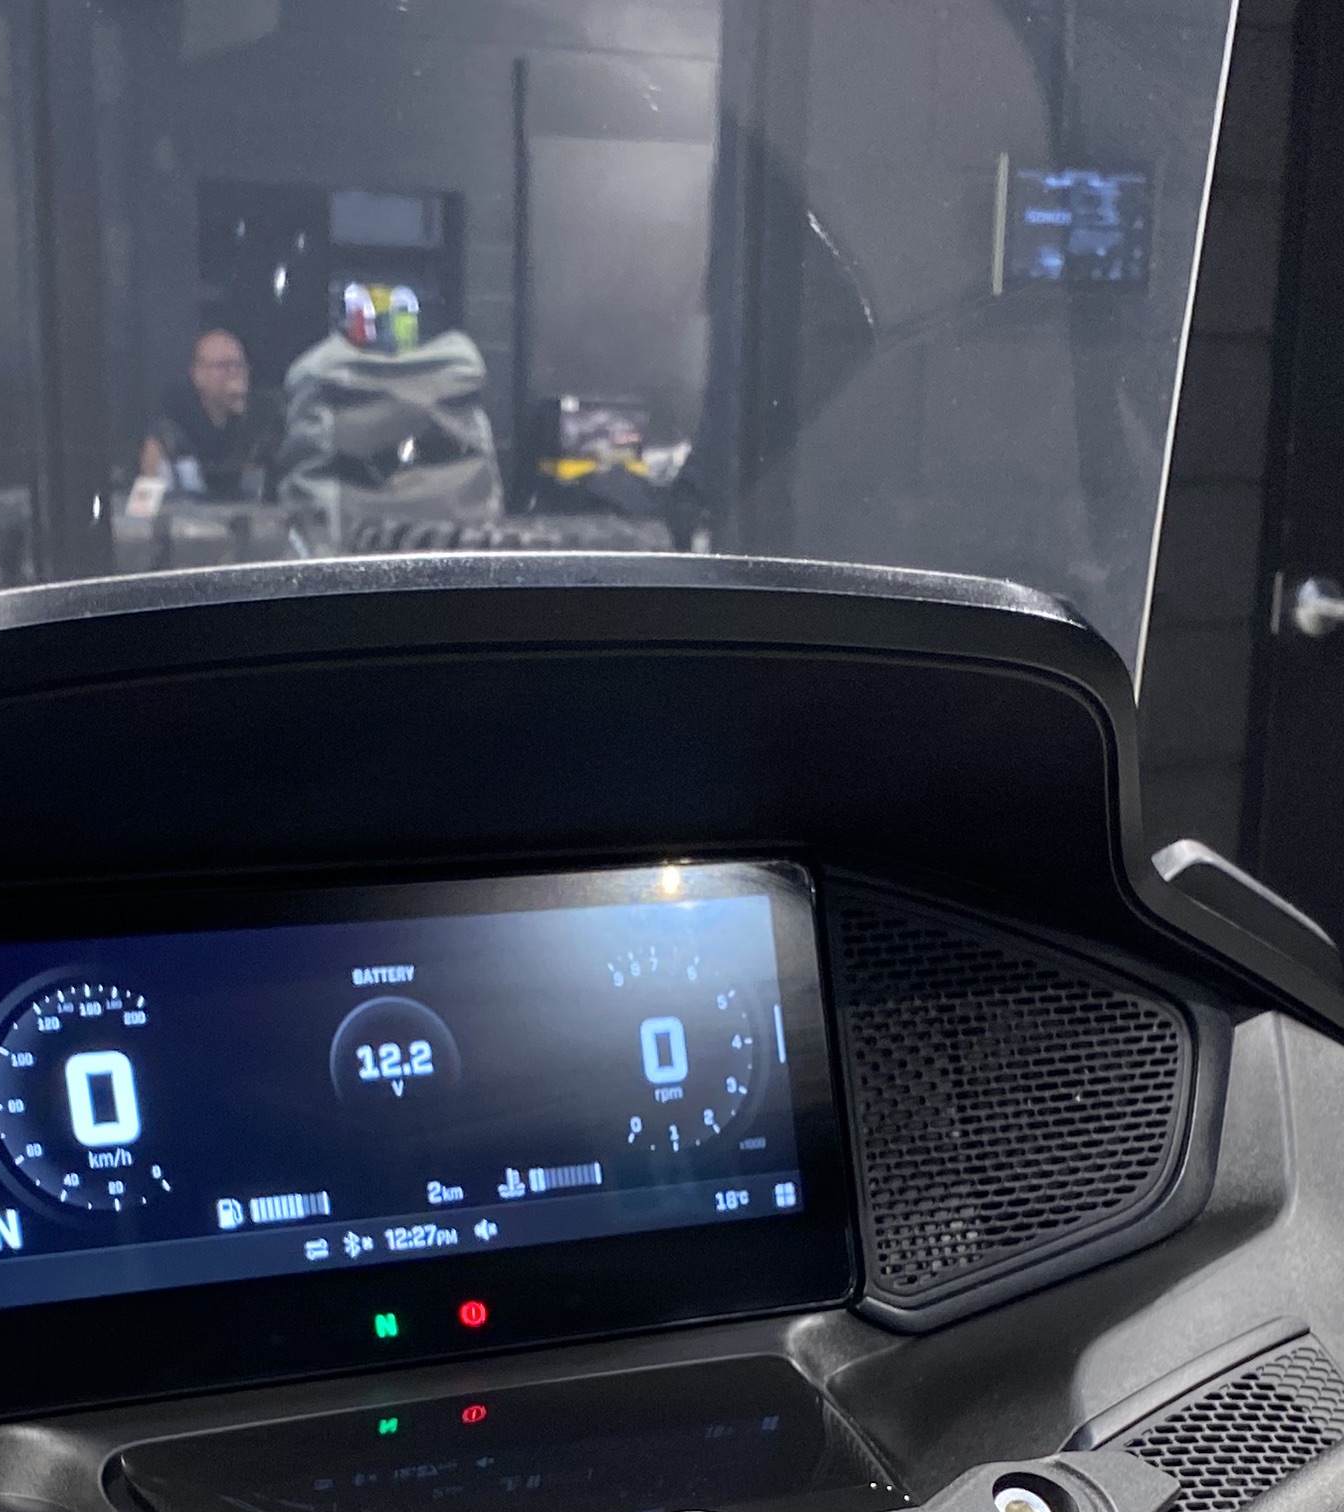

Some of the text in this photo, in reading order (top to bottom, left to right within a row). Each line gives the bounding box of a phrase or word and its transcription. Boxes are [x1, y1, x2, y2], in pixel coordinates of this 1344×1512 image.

[352, 965, 414, 986] BATTERY
[640, 1016, 689, 1085] 0
[732, 1034, 743, 1050] 4
[11, 1052, 34, 1067] 100
[356, 1040, 434, 1080] 12.2
[391, 1079, 404, 1097] V
[726, 1076, 738, 1093] 3
[64, 1050, 143, 1148] 0
[655, 1086, 684, 1103] rpm
[630, 1116, 643, 1133] 0
[703, 1108, 715, 1126] 2
[669, 1124, 680, 1141] 1
[88, 1147, 134, 1170] km/h
[63, 1173, 80, 1187] 40
[151, 1164, 163, 1180] 0
[374, 1312, 398, 1338] N
